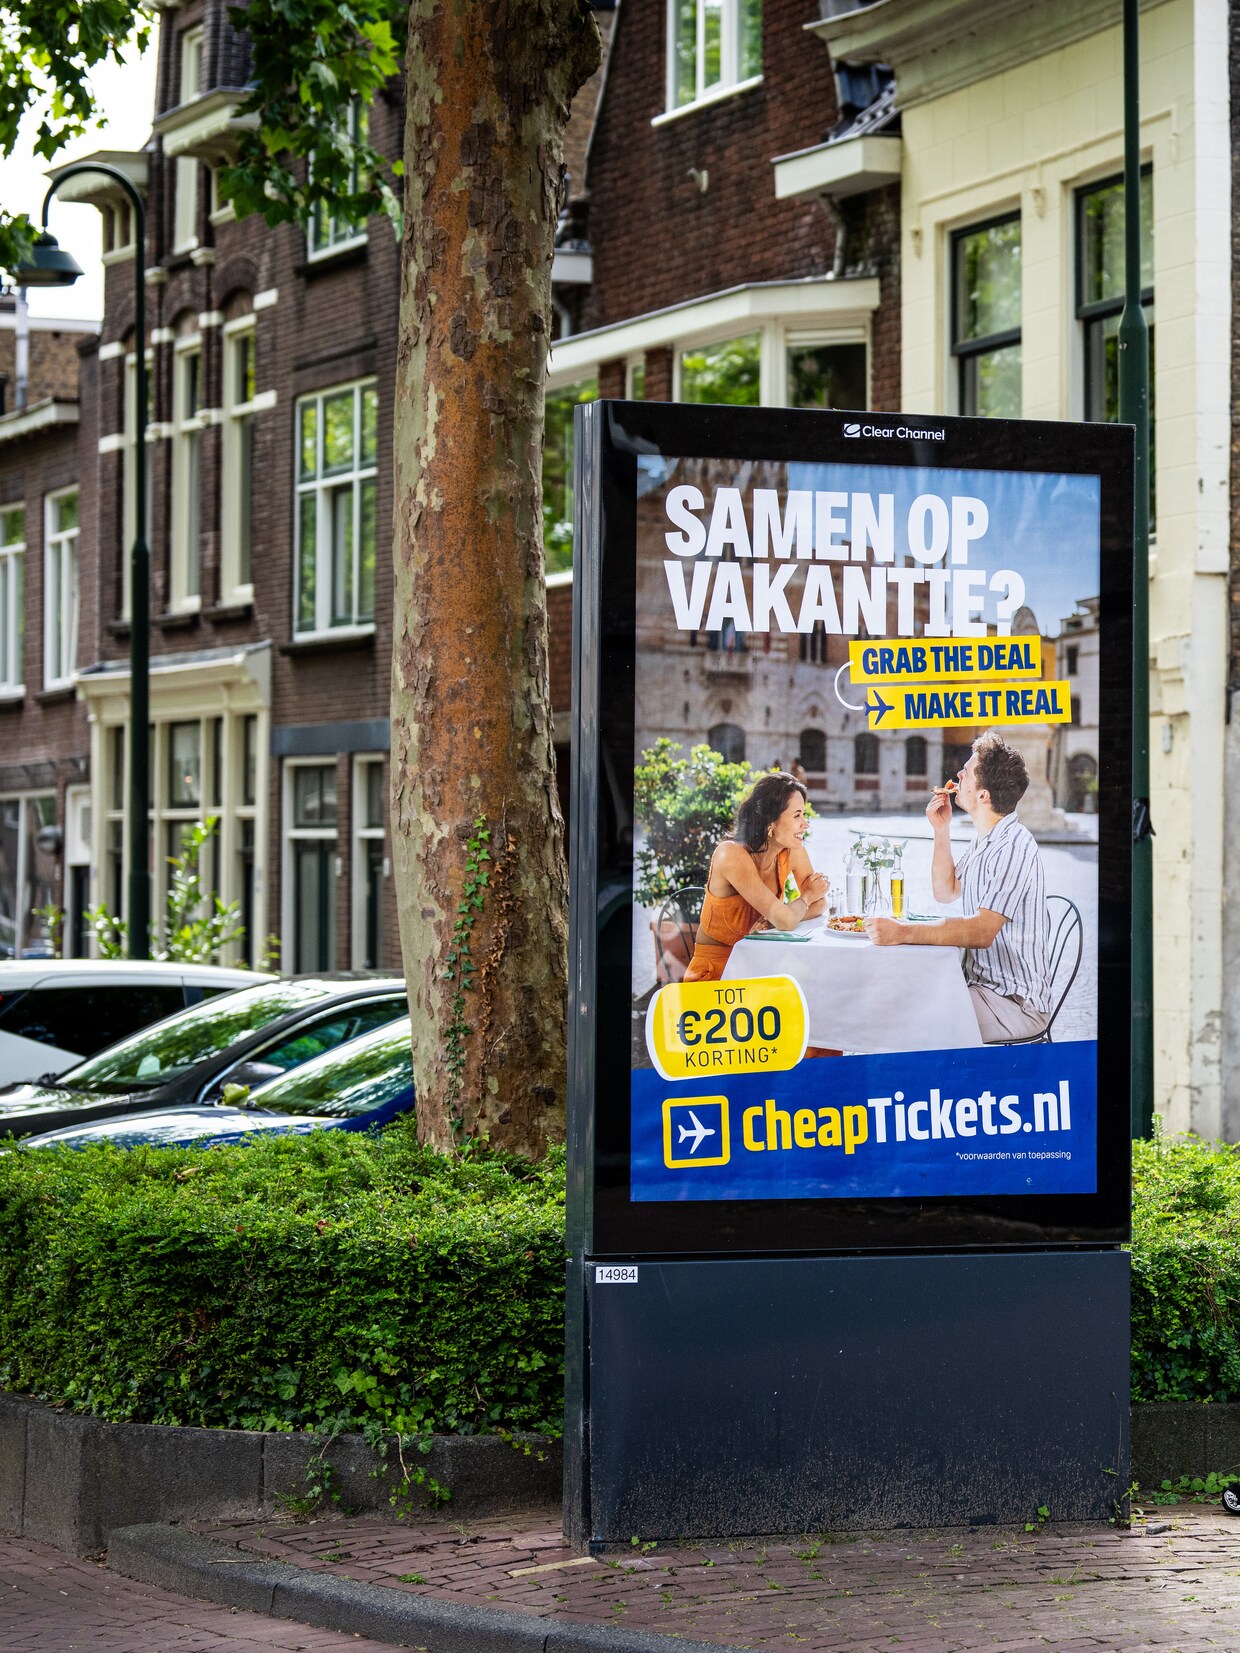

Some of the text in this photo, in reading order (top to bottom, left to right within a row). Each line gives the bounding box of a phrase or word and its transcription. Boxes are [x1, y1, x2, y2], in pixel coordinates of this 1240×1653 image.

[862, 425, 945, 441] Clear Channel
[664, 485, 989, 565] SAMEN OP
[664, 560, 1026, 637] VAKANTIE?
[862, 643, 1036, 675] GRAB THE DEAL
[904, 687, 1063, 720] MAKE IT REAL
[714, 987, 746, 1005] TOT
[676, 1005, 781, 1046] €200
[742, 1080, 1071, 1155] CheapTickets.nl
[1012, 1152, 1027, 1160] van
[1028, 1150, 1072, 1161] toepassing
[599, 1268, 636, 1281] 14984
